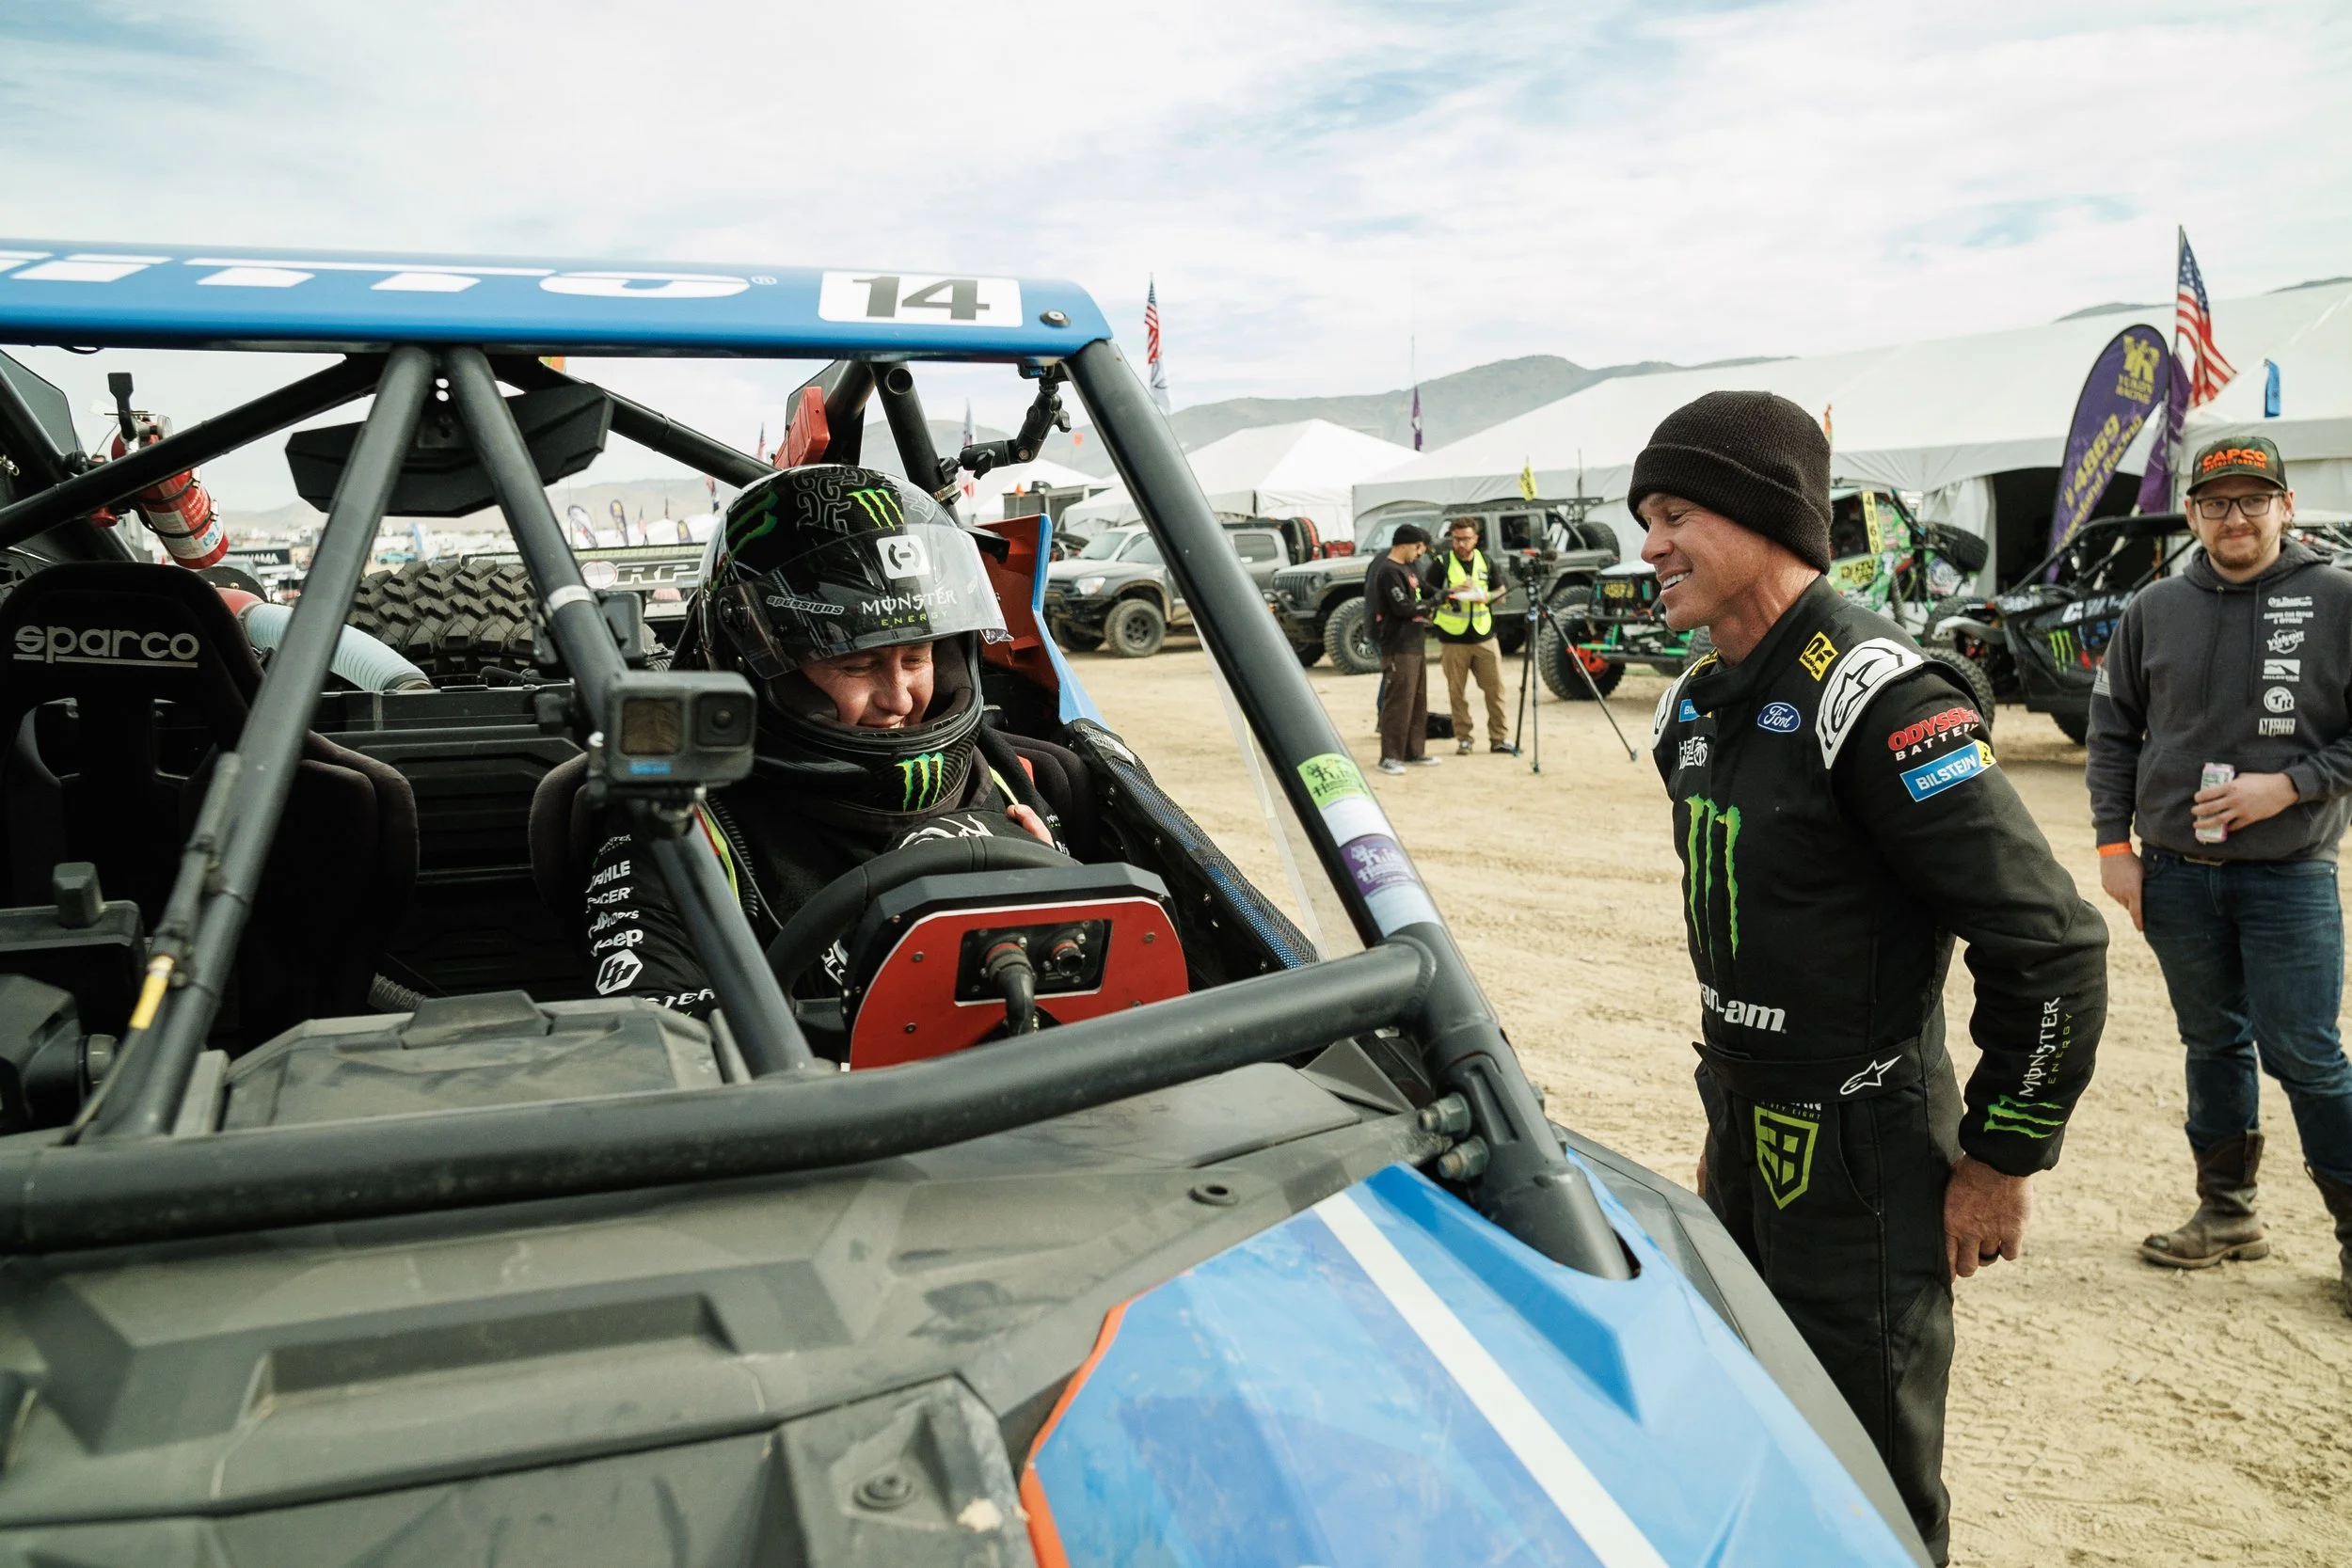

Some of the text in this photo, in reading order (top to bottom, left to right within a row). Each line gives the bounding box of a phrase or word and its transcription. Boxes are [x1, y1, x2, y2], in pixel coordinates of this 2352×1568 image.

[852, 275, 991, 321] 14
[2202, 448, 2267, 467] CAPCO
[766, 594, 845, 616] apdesigns
[862, 586, 958, 617] MONSTER
[881, 610, 949, 627] ENERGY
[14, 625, 200, 664] sparco
[1763, 705, 1795, 729] Ford
[1915, 754, 1978, 791] BILSTEIN
[2018, 996, 2061, 1098] MONSTER
[2047, 1013, 2074, 1085] ENERGY
